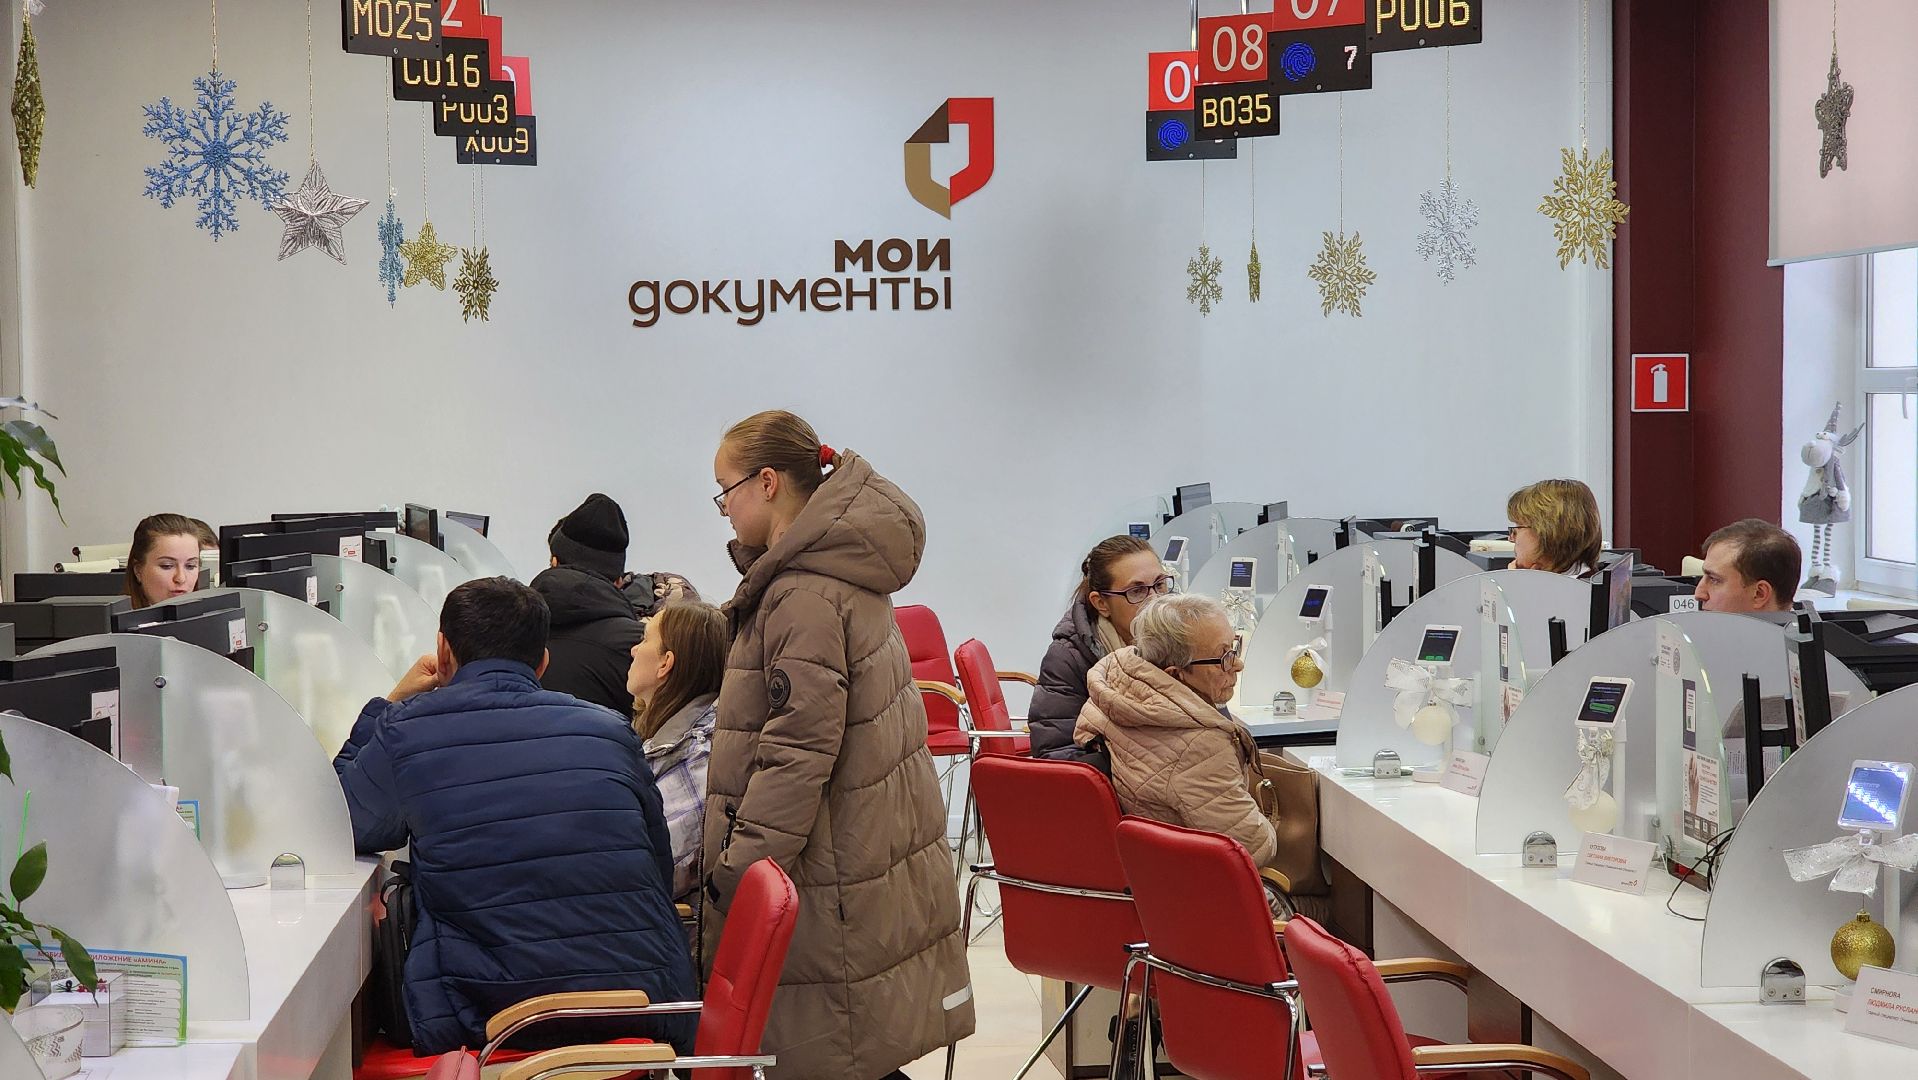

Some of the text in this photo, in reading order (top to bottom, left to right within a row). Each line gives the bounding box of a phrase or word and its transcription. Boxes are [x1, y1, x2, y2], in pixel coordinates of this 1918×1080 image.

[353, 0, 433, 41] М025
[1212, 23, 1264, 72] 08
[1344, 45, 1358, 70] 7
[1163, 60, 1200, 103] 0
[1202, 93, 1272, 128] В035
[627, 276, 953, 328] документы
[1673, 598, 1695, 610] 046
